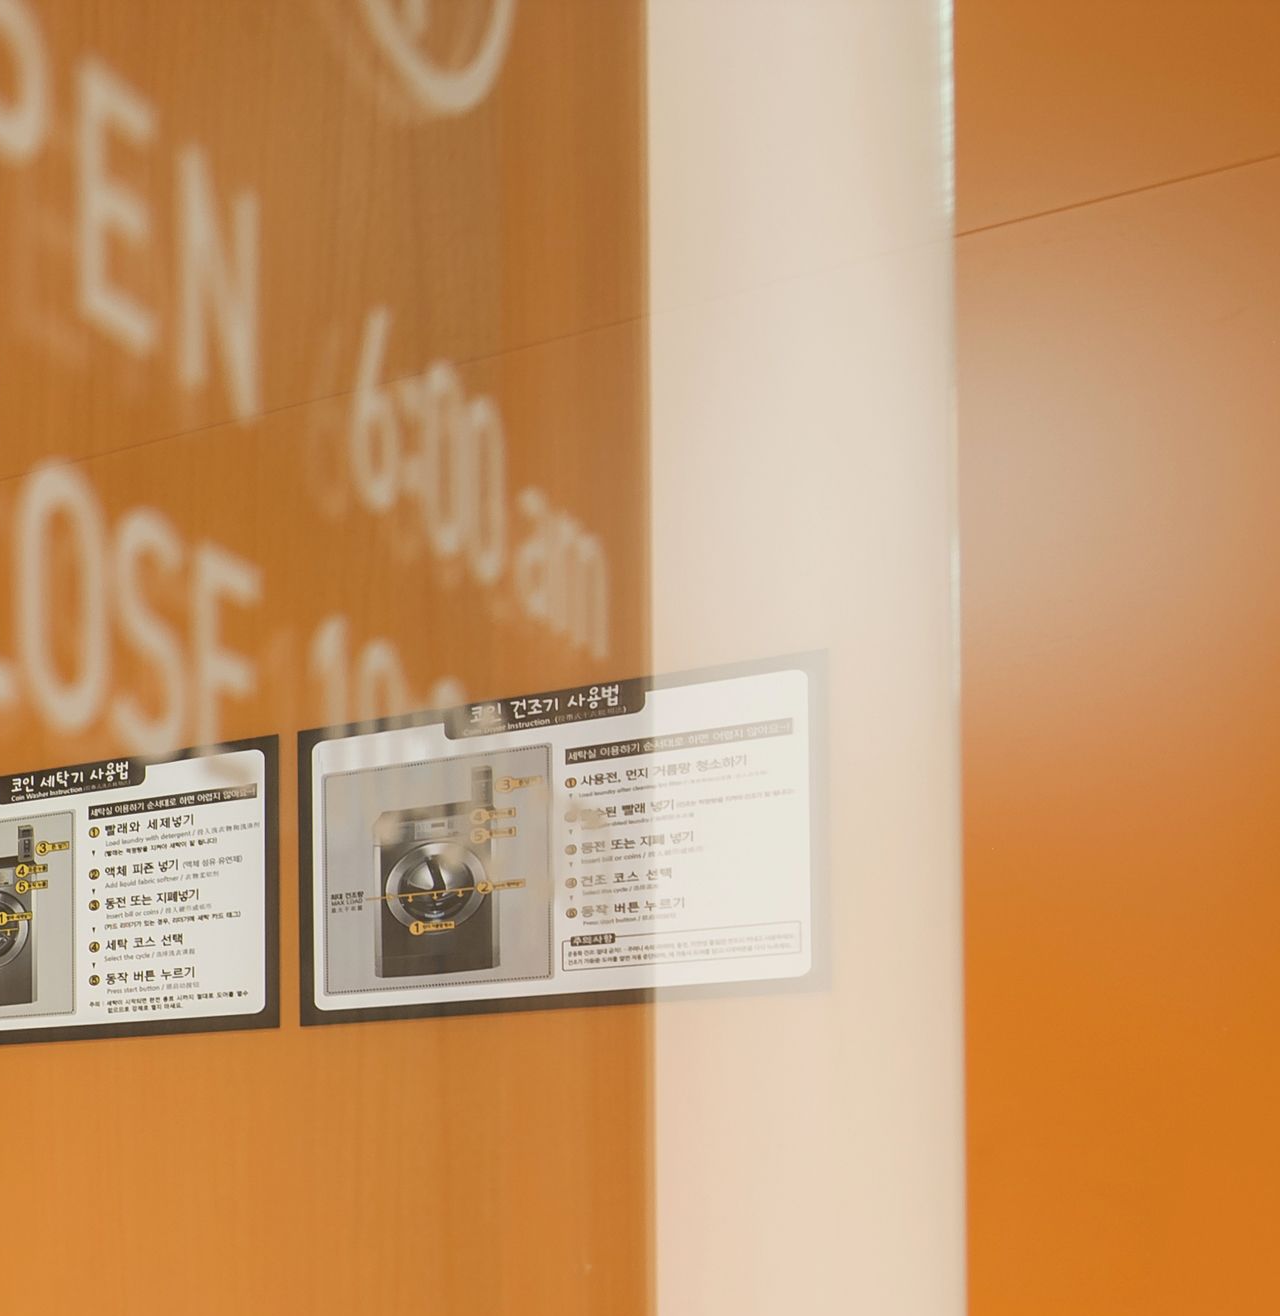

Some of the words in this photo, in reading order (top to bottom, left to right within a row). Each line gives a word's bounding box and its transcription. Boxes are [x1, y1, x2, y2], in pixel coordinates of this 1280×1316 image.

[515, 485, 610, 662] am
[470, 703, 502, 723] 코인
[510, 698, 559, 720] 건조기
[567, 685, 620, 709] 사용법
[507, 717, 551, 731] Instruction
[567, 748, 597, 761] 세탁실
[599, 743, 641, 757] 이용하기
[11, 776, 34, 793] 코인
[40, 771, 84, 788] 세탁기
[89, 761, 129, 782] 사용법
[580, 769, 621, 785] 사용전,
[625, 767, 649, 781] 먼지
[652, 762, 691, 777] 거름망
[696, 754, 748, 772] 청소하기
[50, 786, 83, 796] Instruction
[621, 802, 646, 816] 빨래
[105, 821, 141, 837] 빨래와
[147, 814, 195, 830] 세제넣기
[105, 839, 120, 848] Load
[611, 838, 636, 851] 또는
[640, 834, 665, 847] 지폐
[105, 865, 127, 878] 액체
[158, 859, 179, 872] 넣기
[613, 872, 640, 884] 코스
[105, 897, 127, 910] 동전
[130, 894, 152, 907] 또는
[156, 888, 200, 905] 지폐넣기
[614, 901, 640, 914] 버튼
[105, 939, 128, 951] 세탁
[133, 937, 156, 949] 코스
[161, 933, 184, 946] 선택
[104, 953, 123, 962] Select
[105, 973, 128, 985] 동작
[133, 970, 156, 982] 버튼
[160, 966, 196, 980] 누르기
